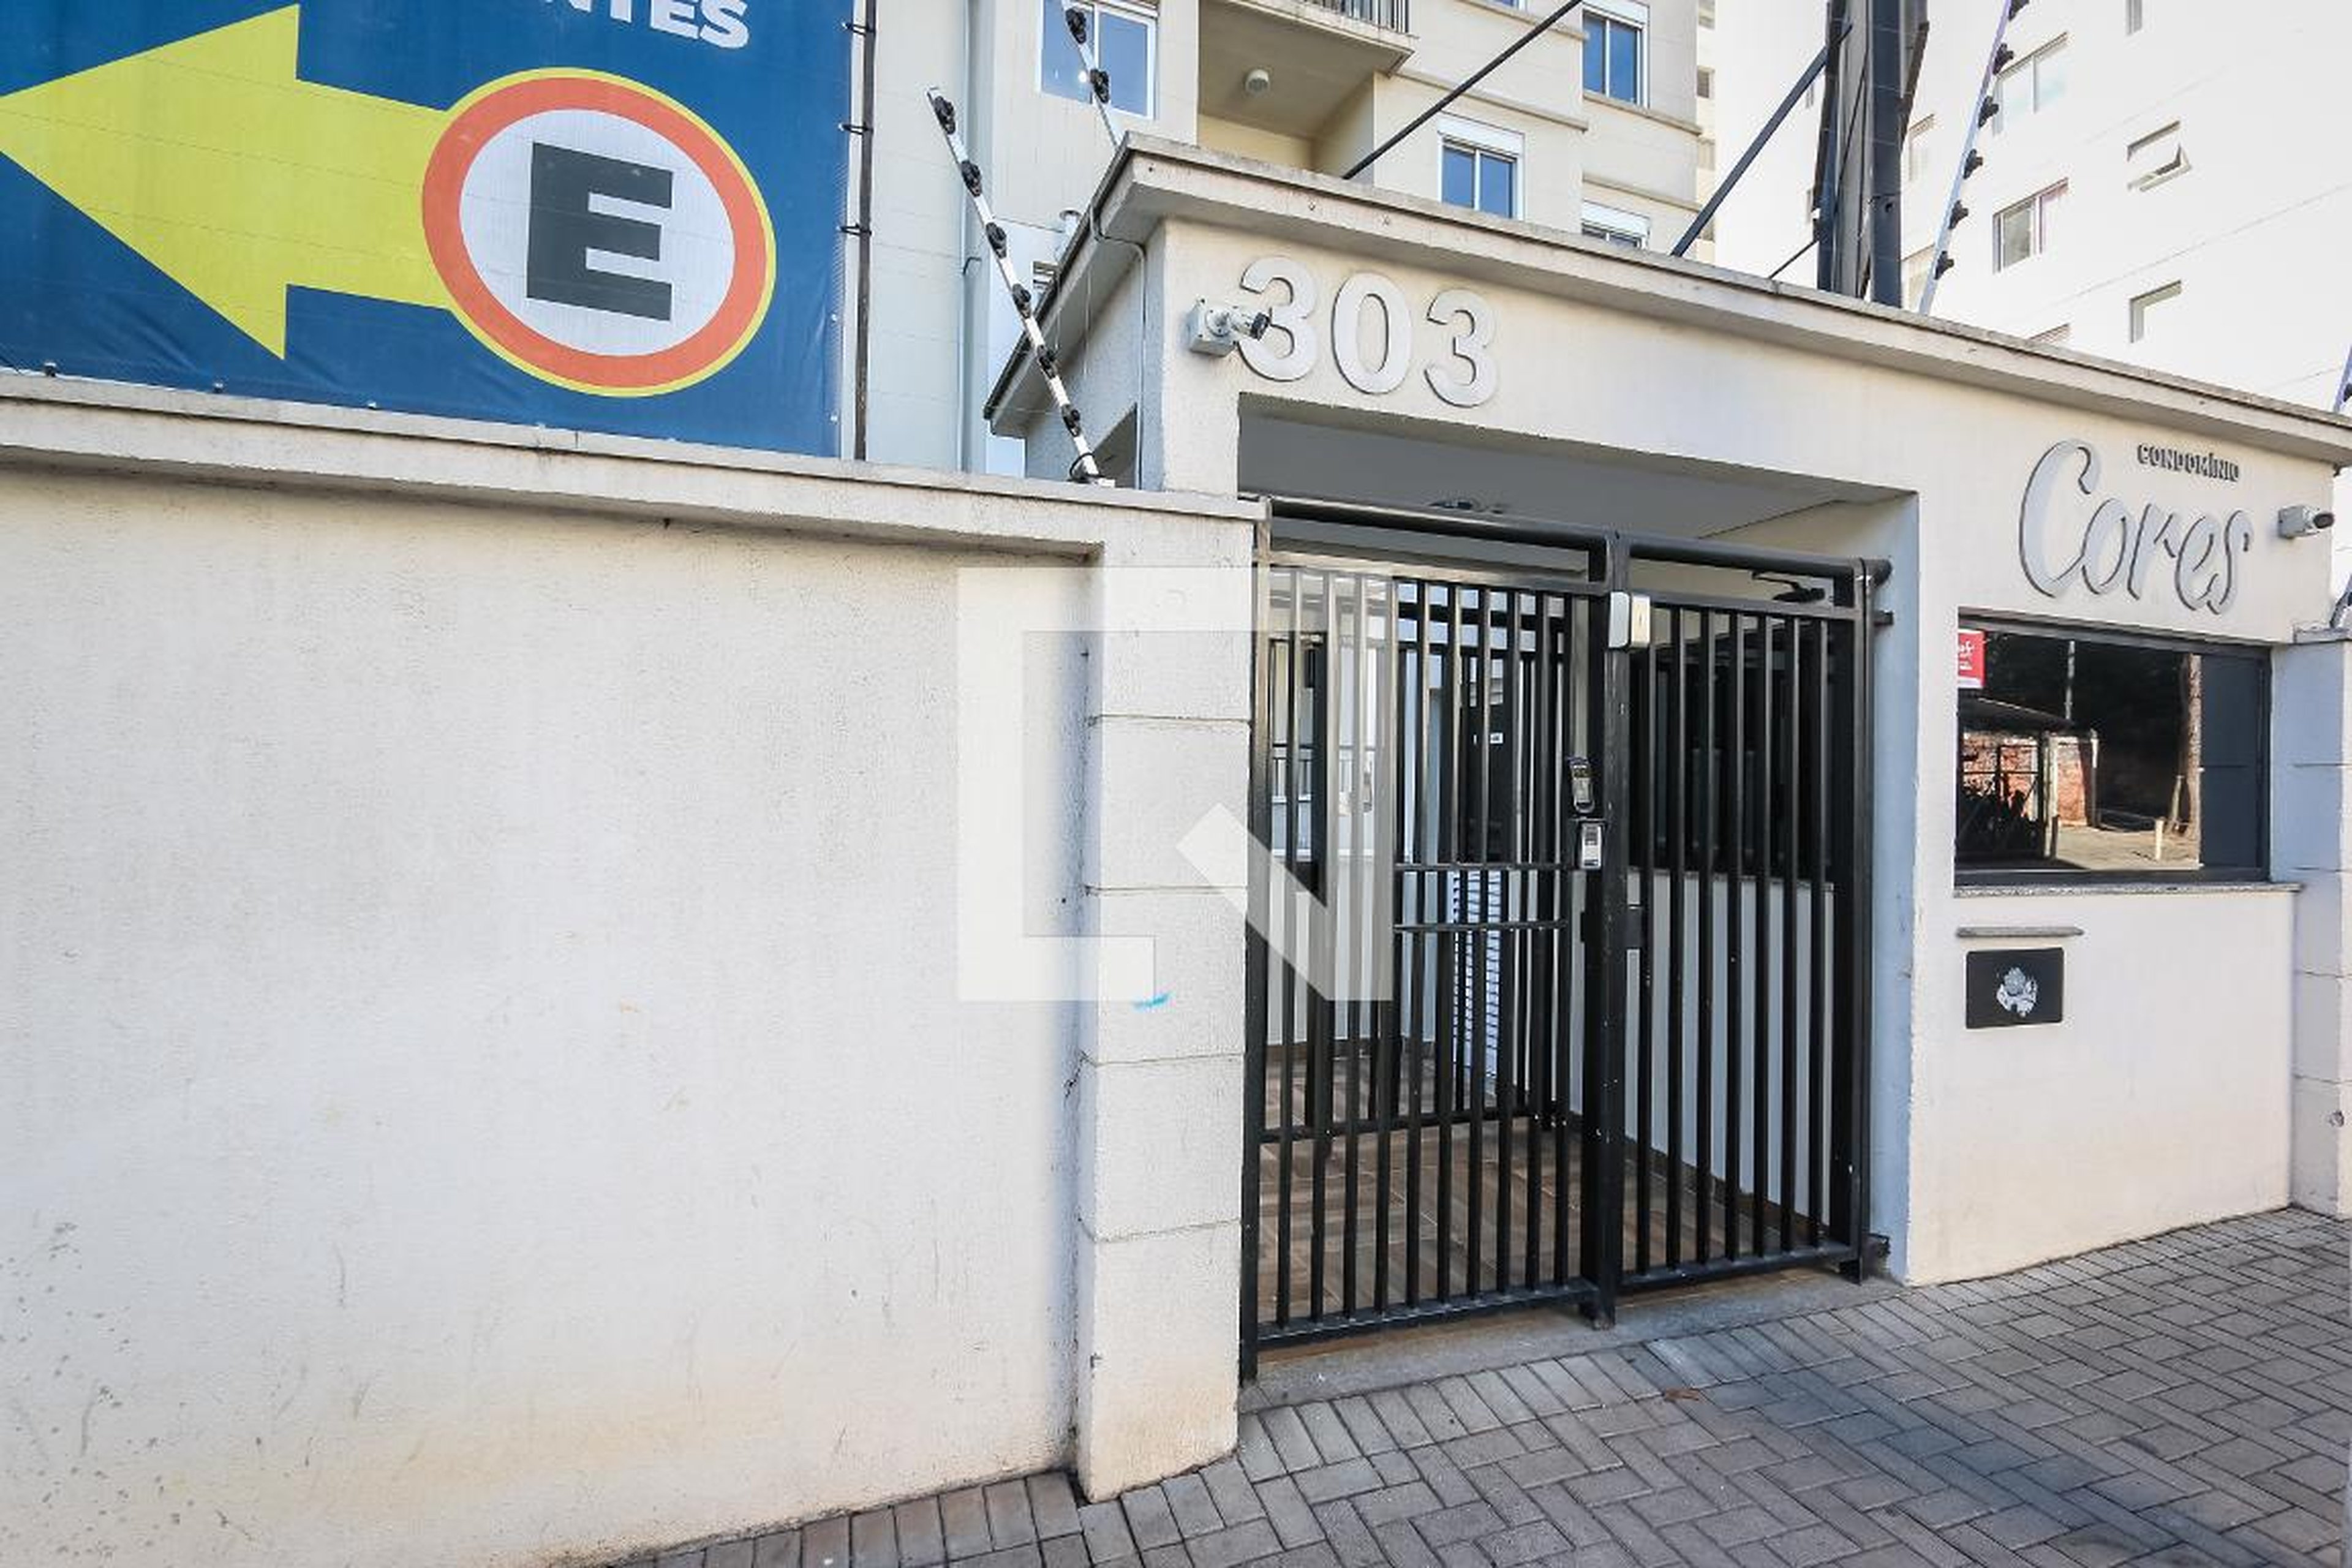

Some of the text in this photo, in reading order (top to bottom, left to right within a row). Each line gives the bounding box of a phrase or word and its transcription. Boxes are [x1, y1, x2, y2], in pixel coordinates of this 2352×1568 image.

[526, 141, 674, 322] E
[1237, 257, 1498, 407] 303
[2020, 438, 2255, 615] Cores
[2137, 444, 2239, 482] CONDOMÍNIO
